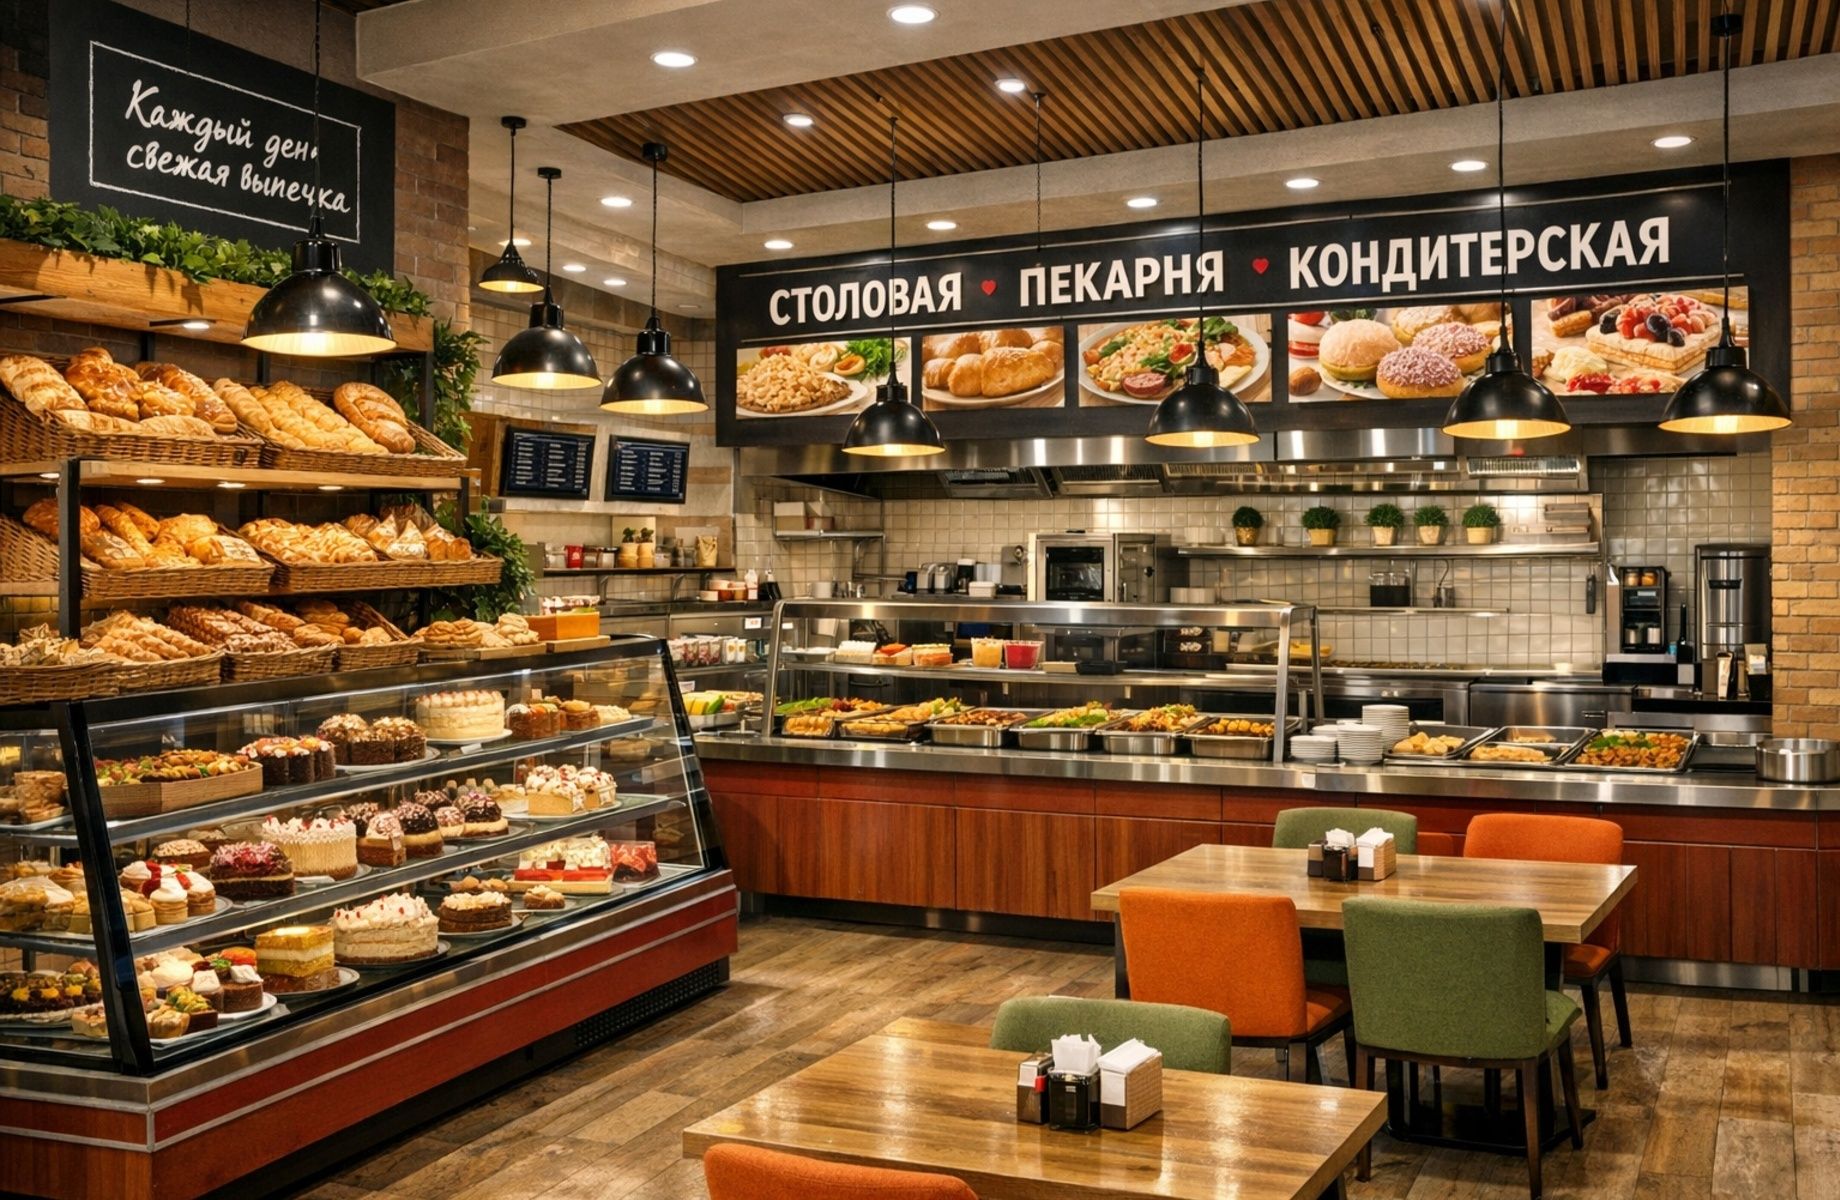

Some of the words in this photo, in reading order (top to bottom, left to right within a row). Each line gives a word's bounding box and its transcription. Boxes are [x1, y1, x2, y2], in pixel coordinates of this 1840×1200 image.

[126, 79, 253, 152] Каждый
[126, 141, 230, 188] свежая
[240, 163, 351, 213] выпечка
[769, 271, 962, 326] СТОЛОВАЯ
[1019, 250, 1224, 307] ПЕКАРНЯ
[1289, 216, 1670, 293] КОНДИТЕРСКАЯ
